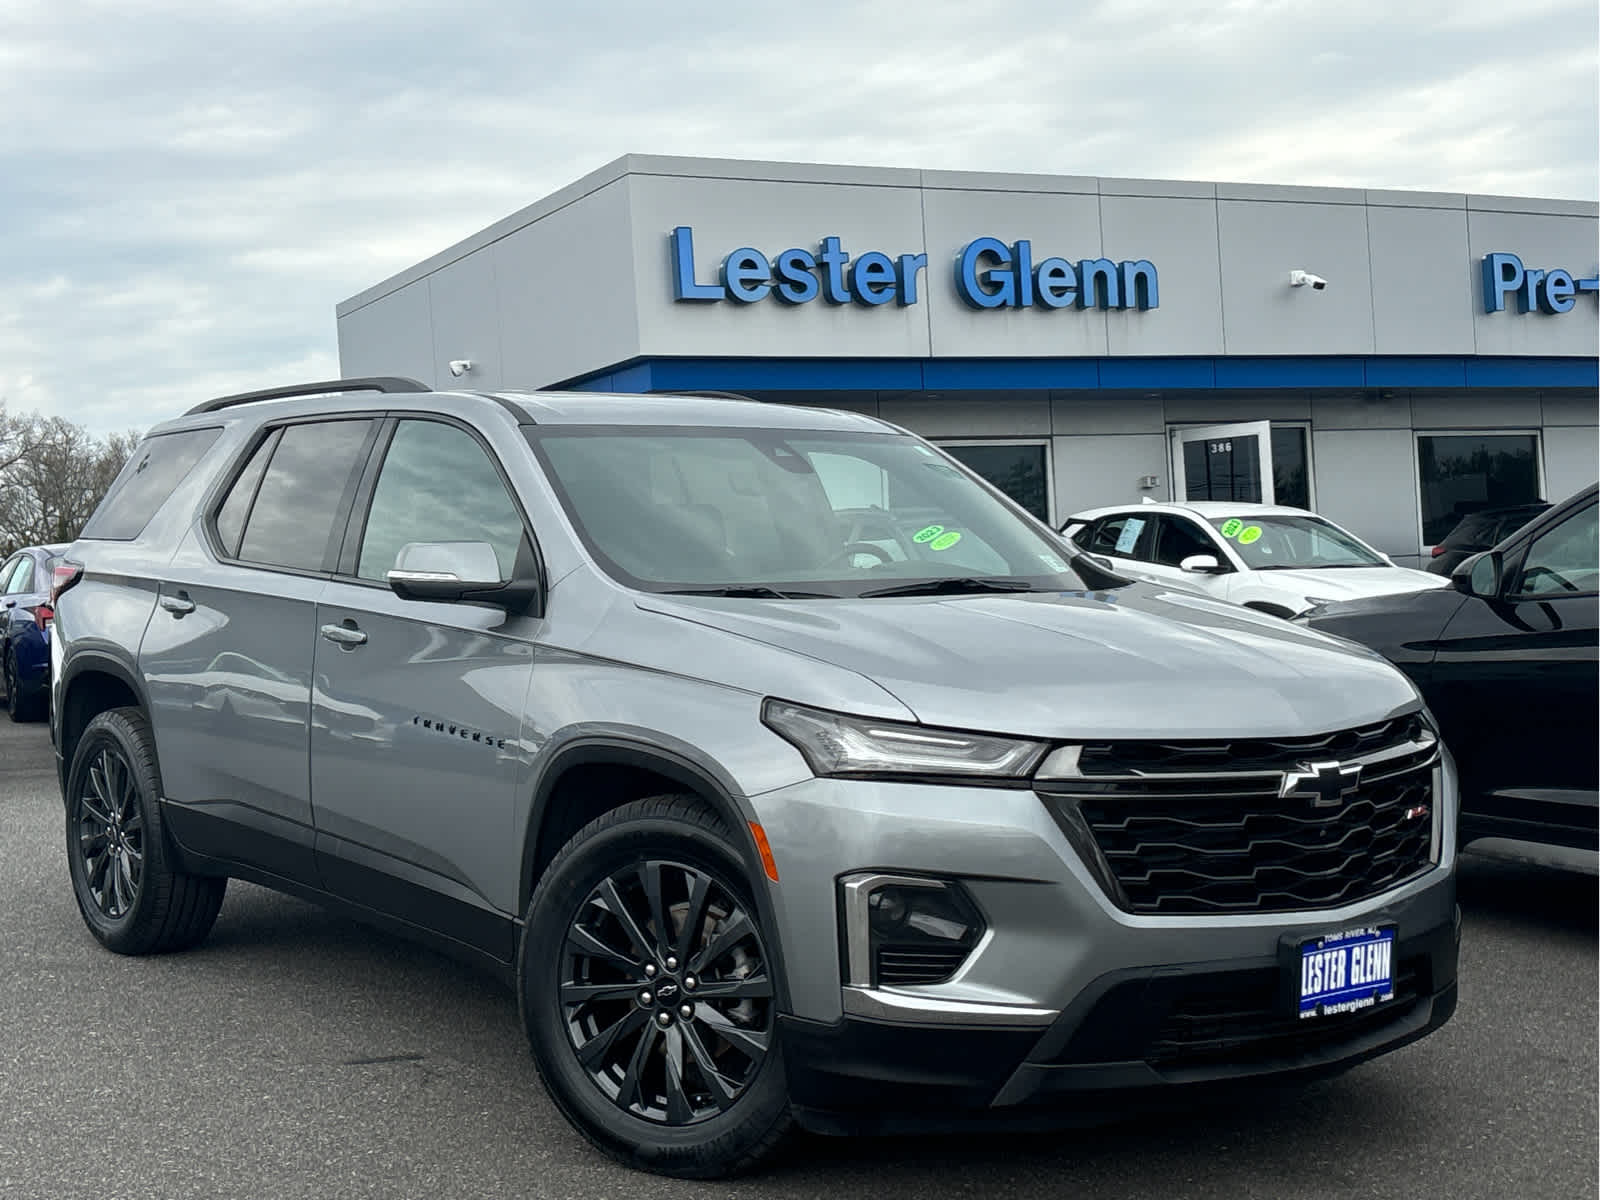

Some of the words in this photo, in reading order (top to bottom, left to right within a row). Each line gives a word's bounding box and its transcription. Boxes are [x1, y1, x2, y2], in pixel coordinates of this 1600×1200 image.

[670, 226, 928, 306] Lester
[955, 236, 1160, 311] Glenn
[1482, 252, 1599, 315] Pre-
[1210, 442, 1232, 454] 386
[1324, 932, 1344, 944] TOMS
[1301, 948, 1347, 996] LESTER
[1351, 941, 1392, 986] GLENN
